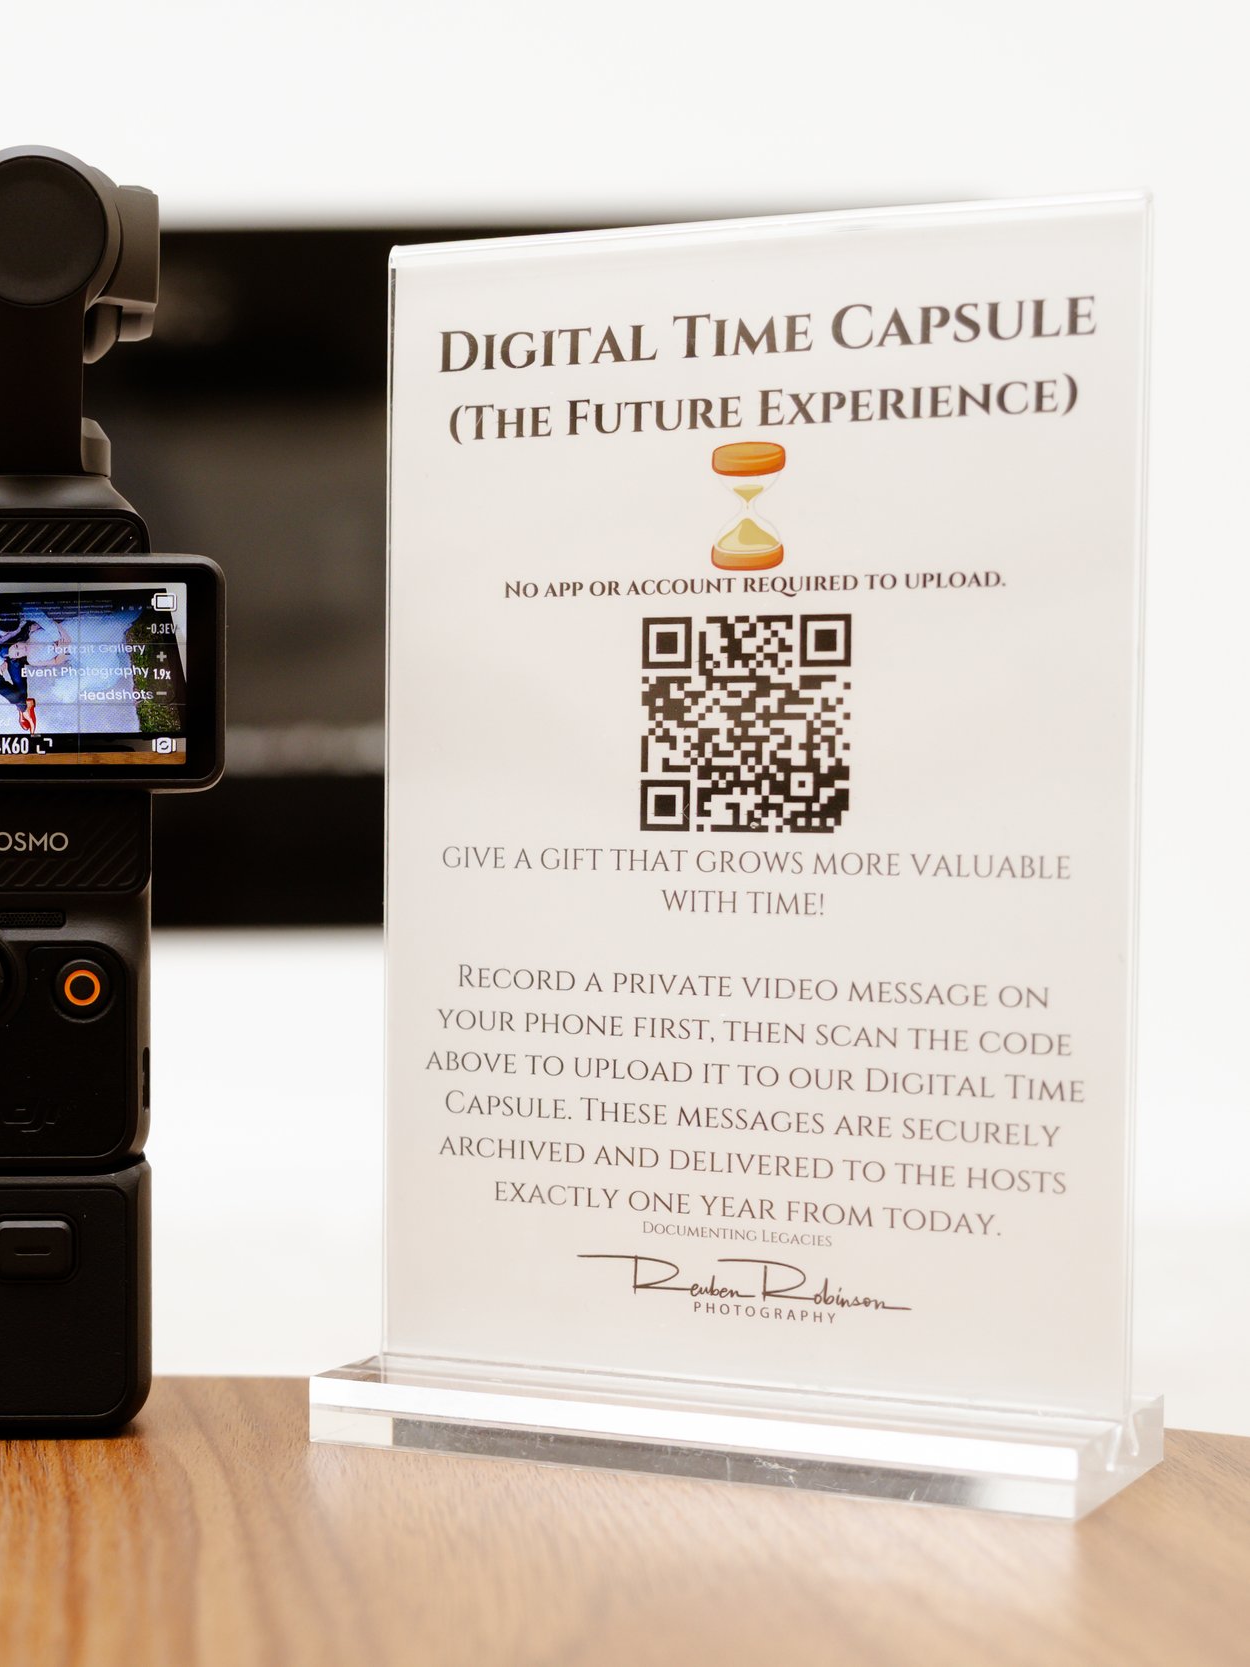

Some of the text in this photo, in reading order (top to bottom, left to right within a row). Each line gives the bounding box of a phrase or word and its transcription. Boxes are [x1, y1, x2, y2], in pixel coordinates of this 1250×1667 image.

[440, 296, 1096, 372] DIGITAL TIME CAPSULE
[450, 374, 1078, 445] (THE FUTURE EXPERIENCE)
[505, 572, 1005, 598] NO APP OR ACCOUNT REQUIRED TO UPLOAD.
[21, 665, 149, 679] Event Photography
[98, 644, 146, 656] Gallery
[153, 668, 171, 680] 1.9x
[443, 846, 1070, 879] GIVE A GIFT THAT GROWS MORE VALUABLE
[662, 890, 823, 915] WITH TIME!
[459, 964, 1048, 1008] RECORD A PRIVATE VIDEO MESSAGE ON
[438, 1009, 1071, 1056] YOUR PHONE FIRST, THEN SCAN THE CODE
[426, 1051, 1084, 1103] ABOVE TO UPLOAD IT TO OUR DIGITAL TIME
[446, 1090, 1060, 1147] CAPSULE. THESE MESSAGES ARE SECURELY
[440, 1136, 1066, 1194] ARCHIVED AND DELIVERED TO THE HOSTS
[495, 1181, 1001, 1236] EXACTLY ONE YEAR FROM TODAY.
[643, 1221, 832, 1247] DOCUMENTING LEGACIES
[577, 1254, 912, 1311] Reuben Robinson
[694, 1302, 835, 1323] PHOTOGRAPHY
